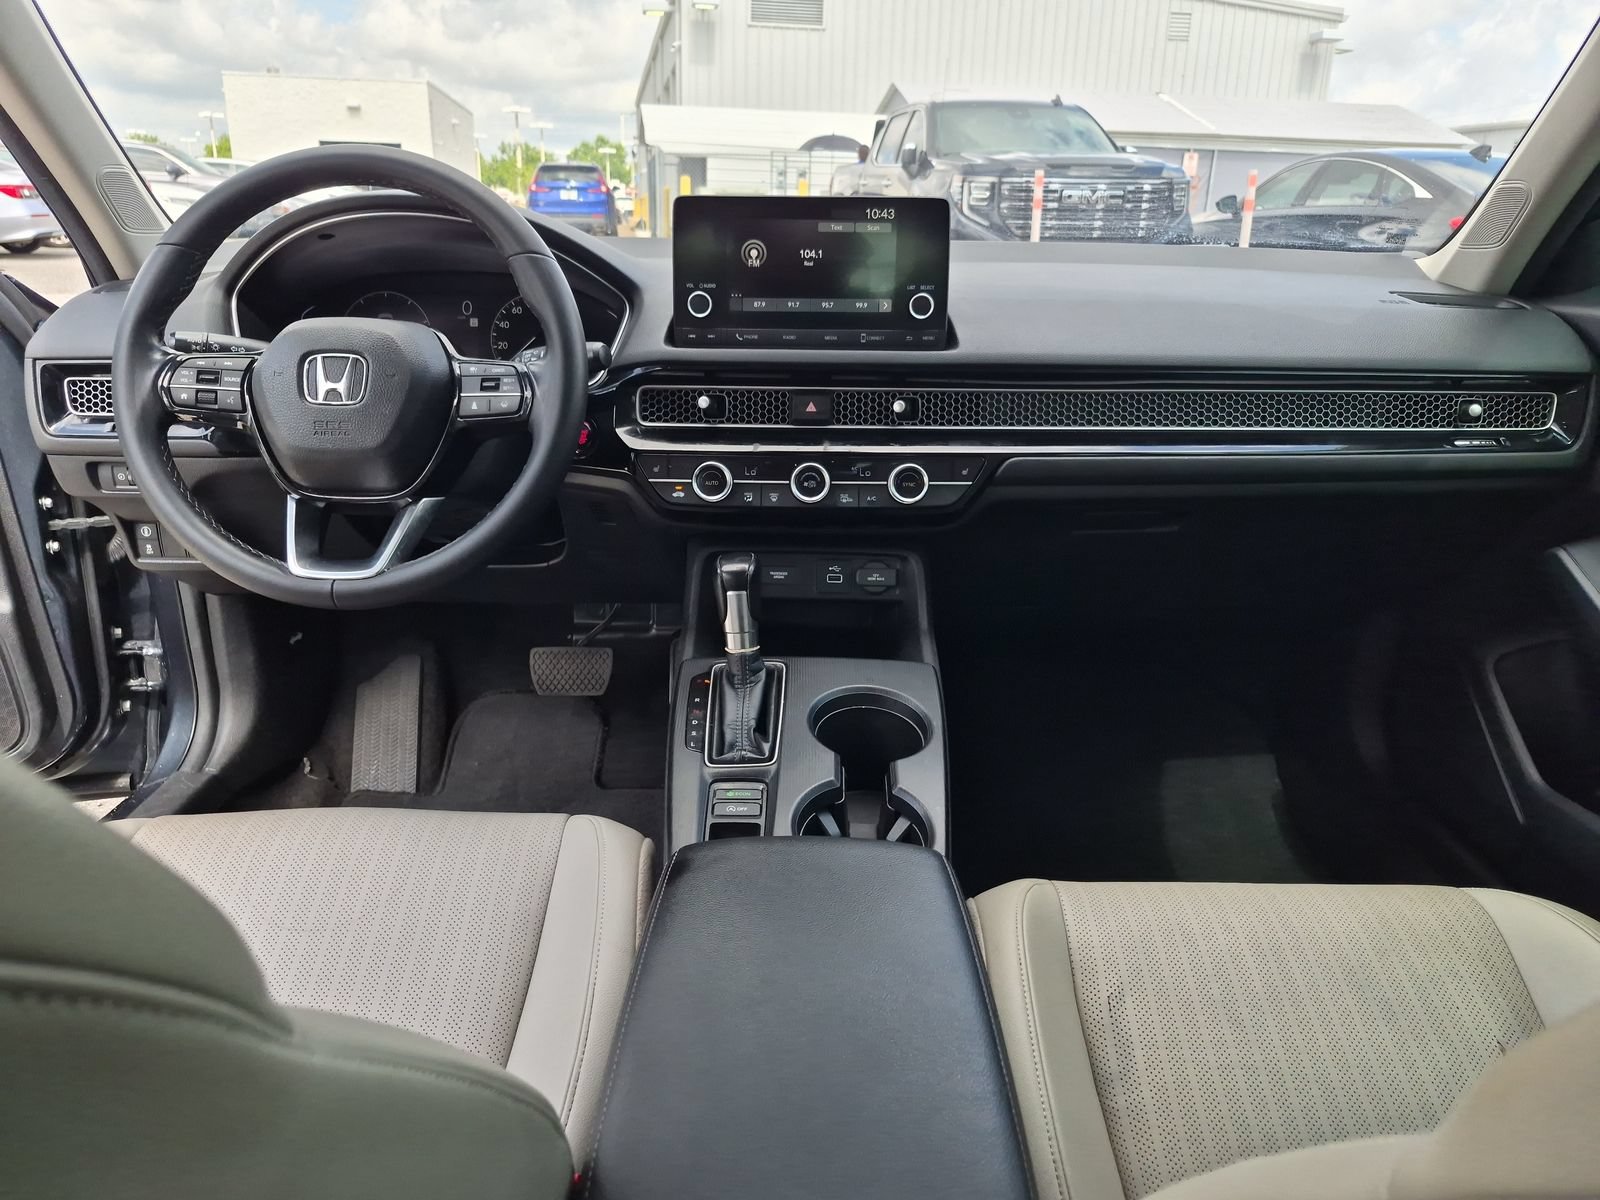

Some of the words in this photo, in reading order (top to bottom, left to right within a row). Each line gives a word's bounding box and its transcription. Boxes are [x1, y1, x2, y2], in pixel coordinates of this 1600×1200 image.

[1061, 189, 1125, 204] GMC
[865, 207, 896, 220] 10:43
[799, 248, 823, 259] 104.1
[748, 259, 760, 268] FM
[753, 300, 766, 308] 87.9
[821, 301, 834, 309] 95.7
[511, 306, 523, 315] 60
[499, 321, 510, 329] 40
[497, 341, 509, 350] 20
